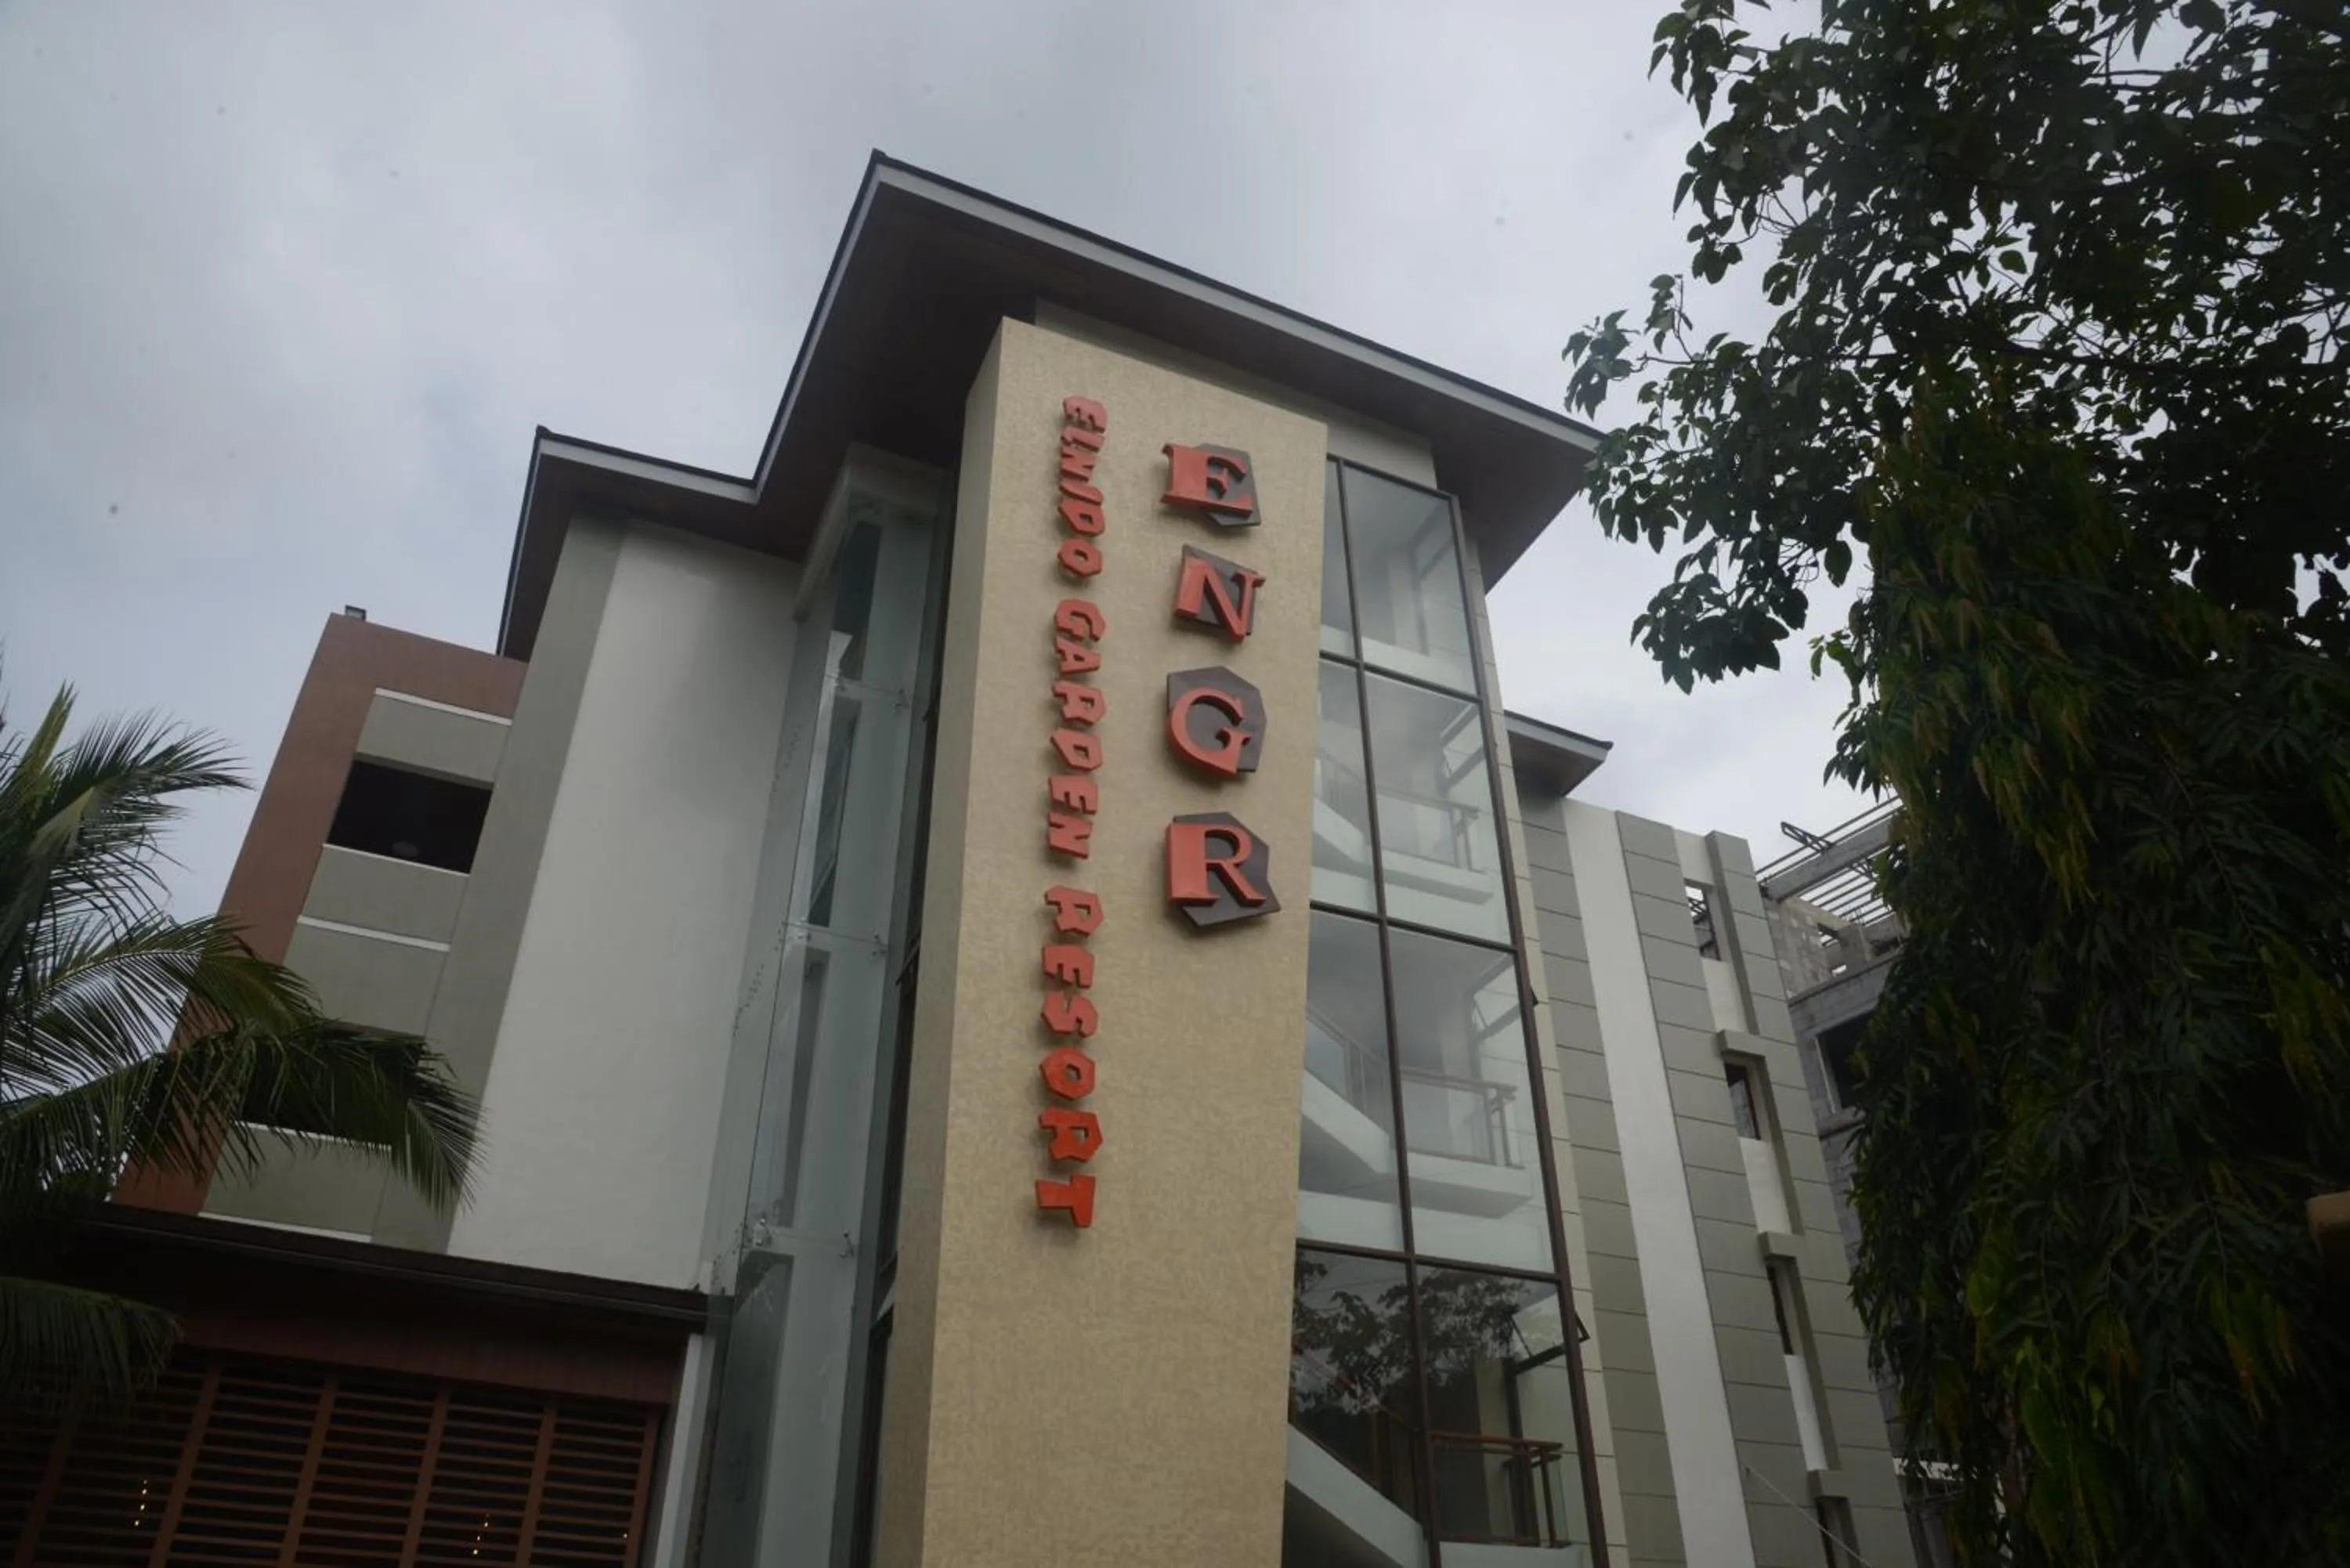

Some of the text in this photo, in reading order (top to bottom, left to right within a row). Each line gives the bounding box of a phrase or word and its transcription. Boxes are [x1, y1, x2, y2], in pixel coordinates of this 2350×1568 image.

[1047, 598, 1106, 859] GARDEN
[1159, 442, 1267, 909] ENGR
[1035, 884, 1104, 1227] RESORT
